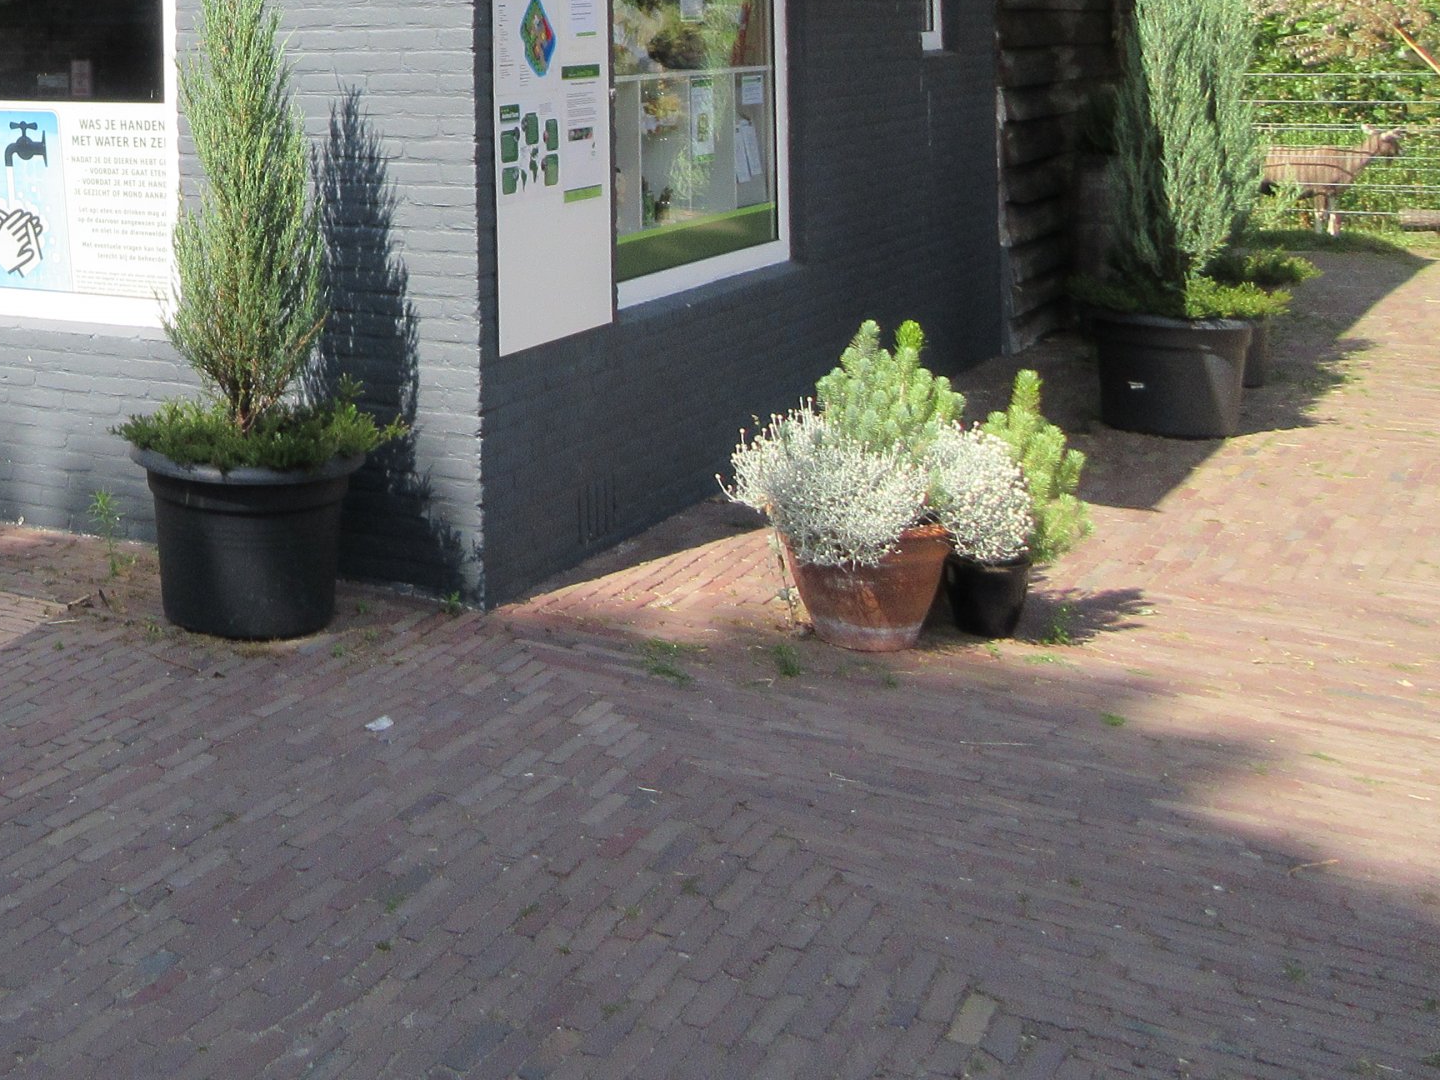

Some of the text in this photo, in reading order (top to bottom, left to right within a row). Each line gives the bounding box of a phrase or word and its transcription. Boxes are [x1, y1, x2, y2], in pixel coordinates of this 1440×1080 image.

[79, 119, 165, 131] WAS JE HANDEN
[71, 135, 166, 148] MET WATER EN ZE
[94, 156, 101, 164] JE
[114, 157, 138, 165] DIEREN
[90, 167, 119, 175] VOORDAT
[121, 168, 129, 176] JE
[82, 178, 111, 186] VOORDAT
[138, 180, 146, 188] JE
[83, 189, 110, 197] GEZICHT
[123, 207, 146, 216] drinken
[147, 209, 160, 218] mag
[100, 226, 112, 234] niet
